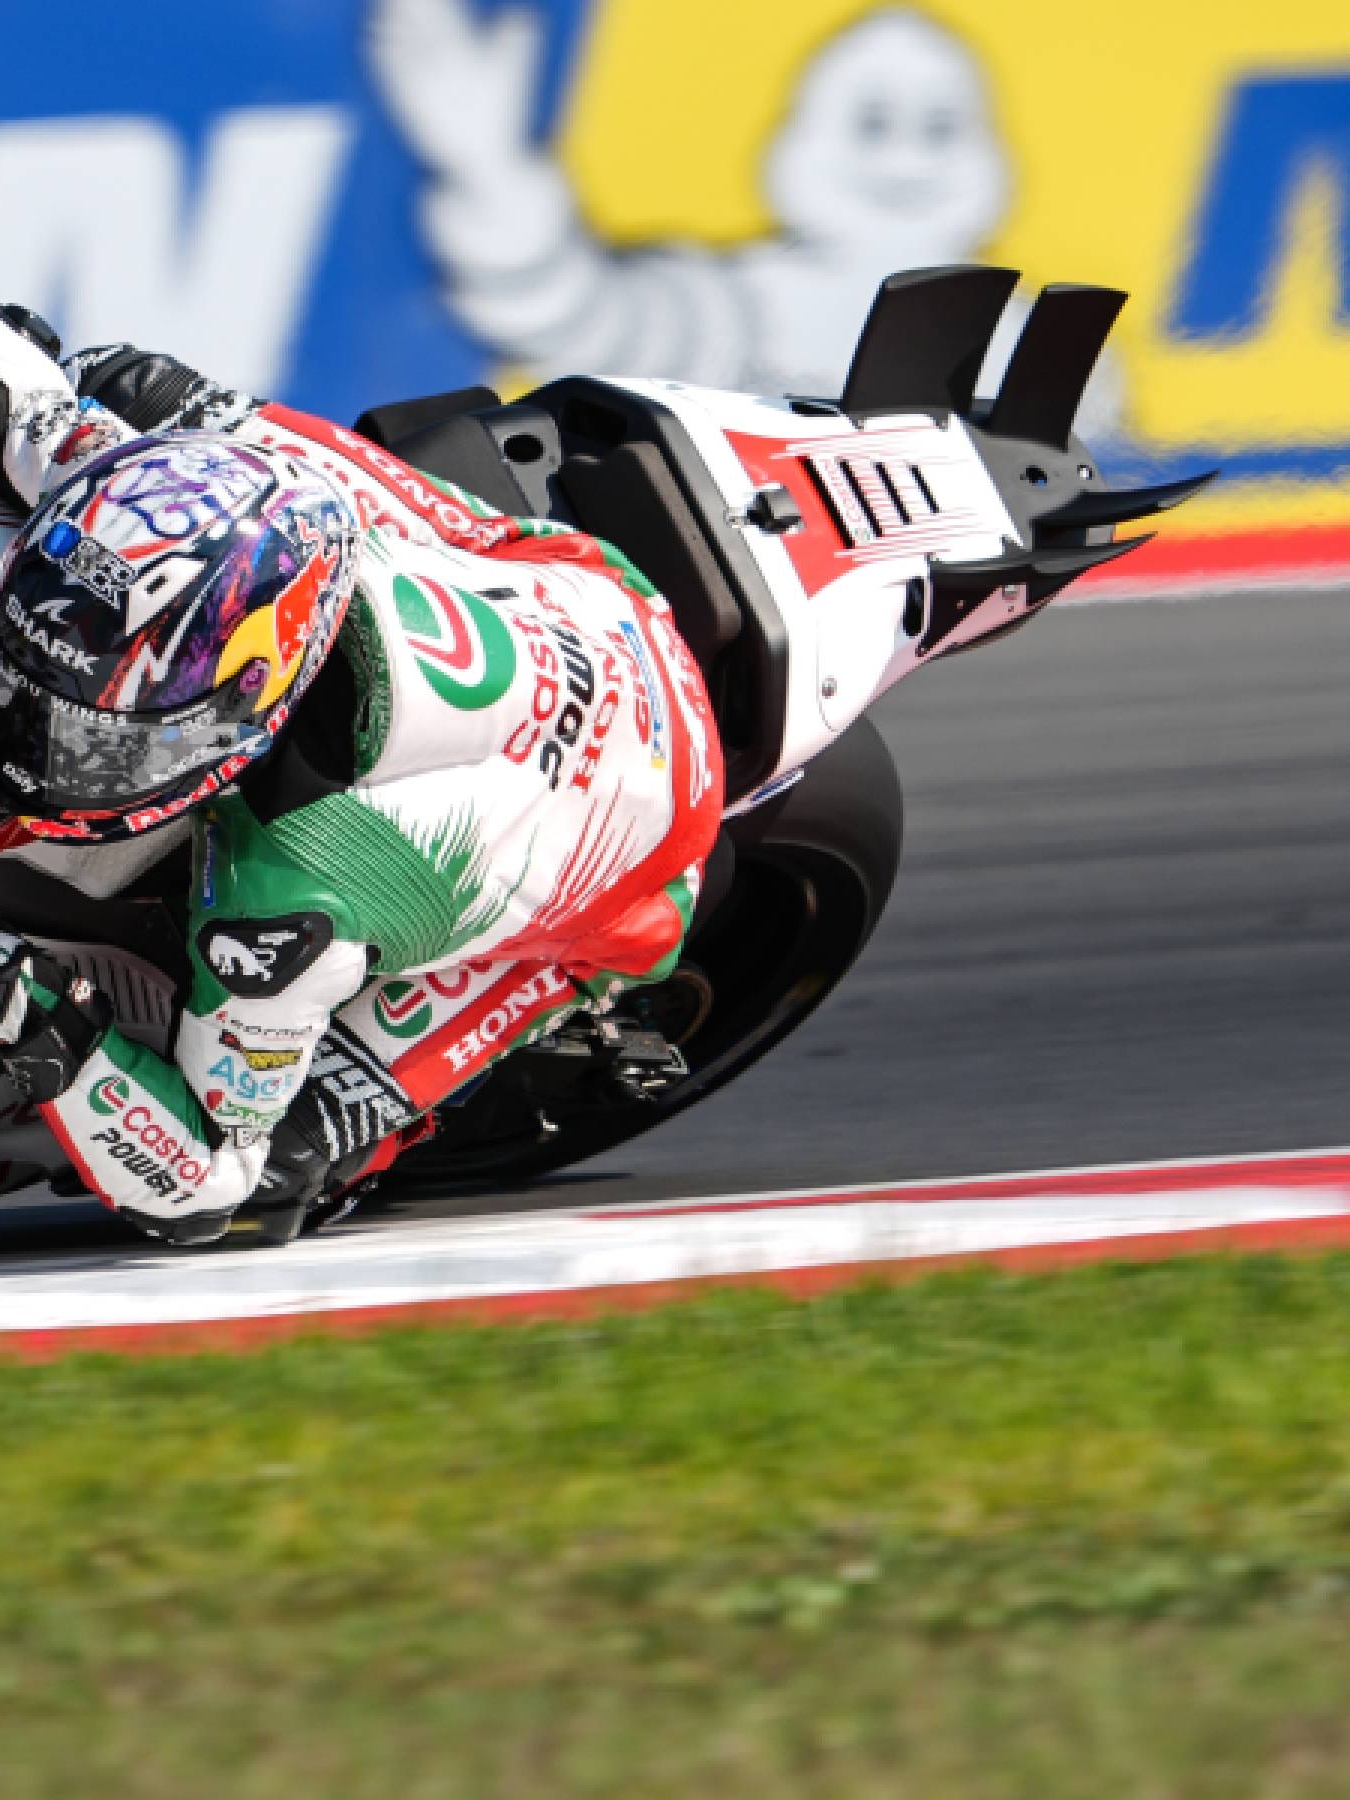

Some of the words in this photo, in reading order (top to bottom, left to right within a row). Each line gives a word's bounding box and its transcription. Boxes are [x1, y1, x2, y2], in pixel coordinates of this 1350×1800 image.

[5, 594, 101, 675] SHARK
[443, 968, 571, 1074] HON
[123, 1106, 211, 1185] Castrol
